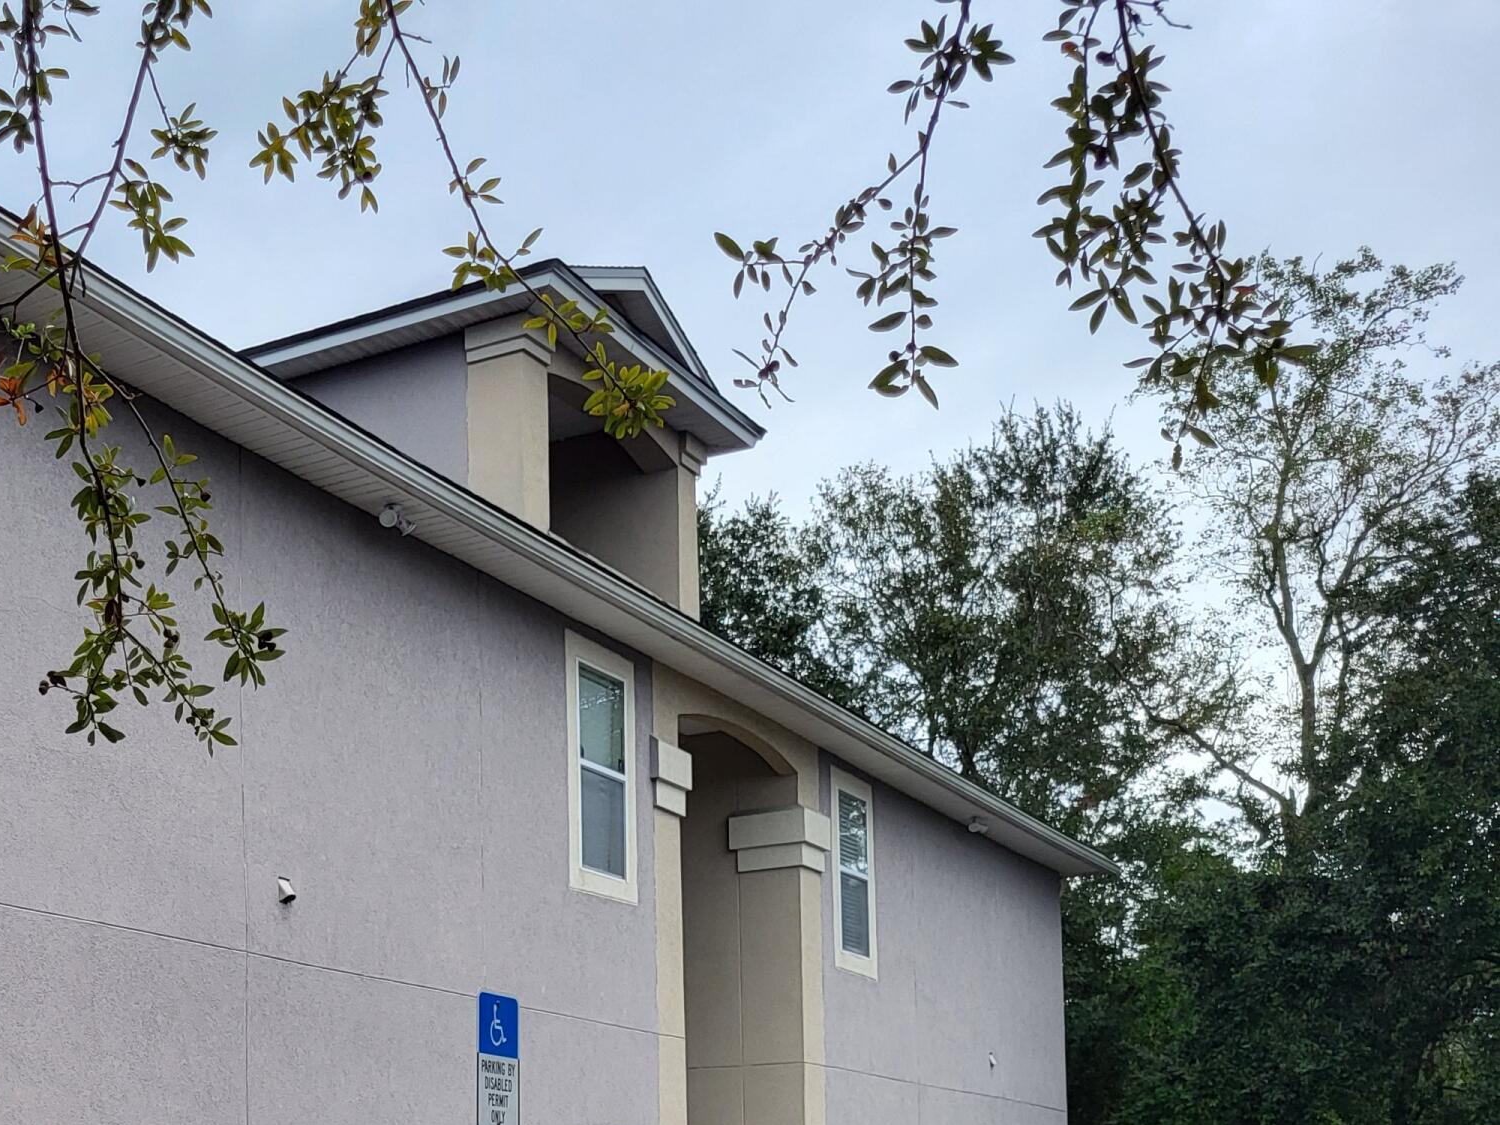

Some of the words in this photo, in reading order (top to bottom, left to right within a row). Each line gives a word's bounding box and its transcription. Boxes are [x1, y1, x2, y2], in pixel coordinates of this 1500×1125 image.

[481, 1059, 506, 1076] PARKING
[507, 1063, 515, 1077] BY
[484, 1076, 512, 1092] DISABLED
[488, 1093, 509, 1108] PERMIT
[491, 1110, 506, 1124] ONLY
